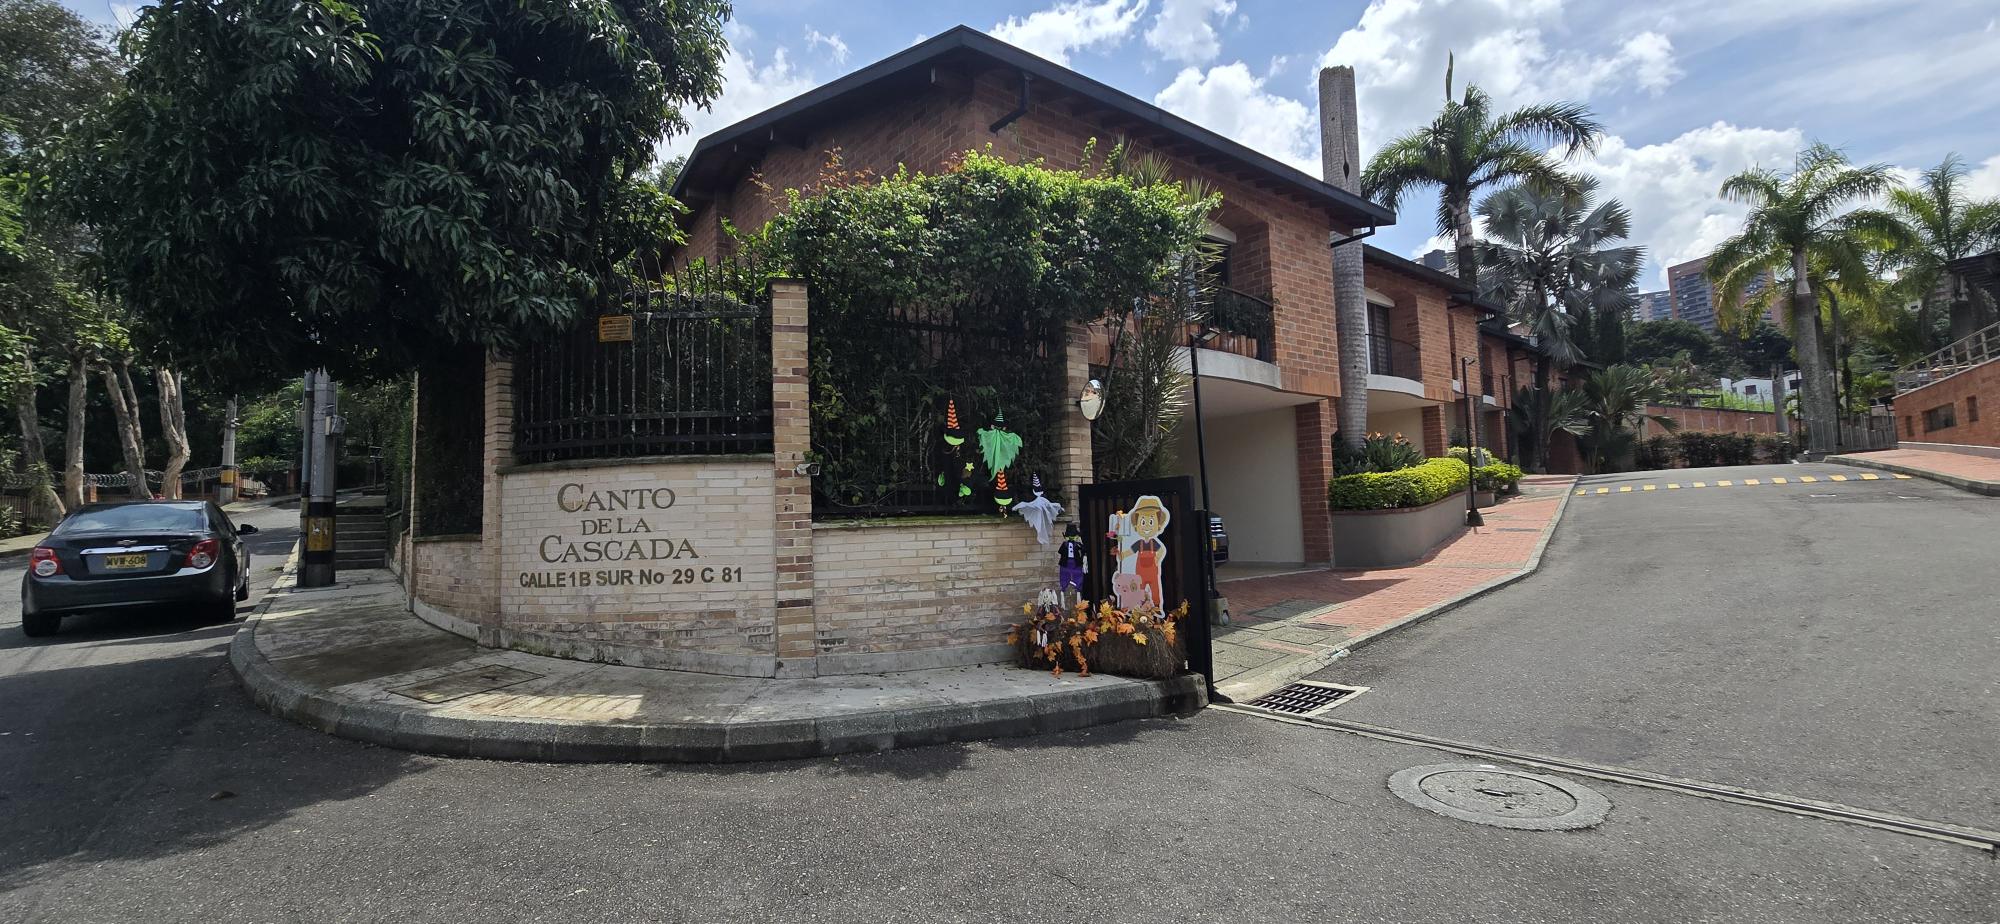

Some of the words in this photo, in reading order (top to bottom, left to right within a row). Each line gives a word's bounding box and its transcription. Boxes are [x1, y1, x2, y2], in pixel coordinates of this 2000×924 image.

[557, 483, 676, 513] CANTO
[581, 518, 612, 535] DE
[616, 517, 652, 533] LA
[539, 534, 700, 564] CASCADA
[595, 570, 633, 588] SUR
[639, 569, 665, 586] No
[672, 568, 695, 586] 29
[700, 567, 715, 584] C
[721, 566, 743, 584] 81
